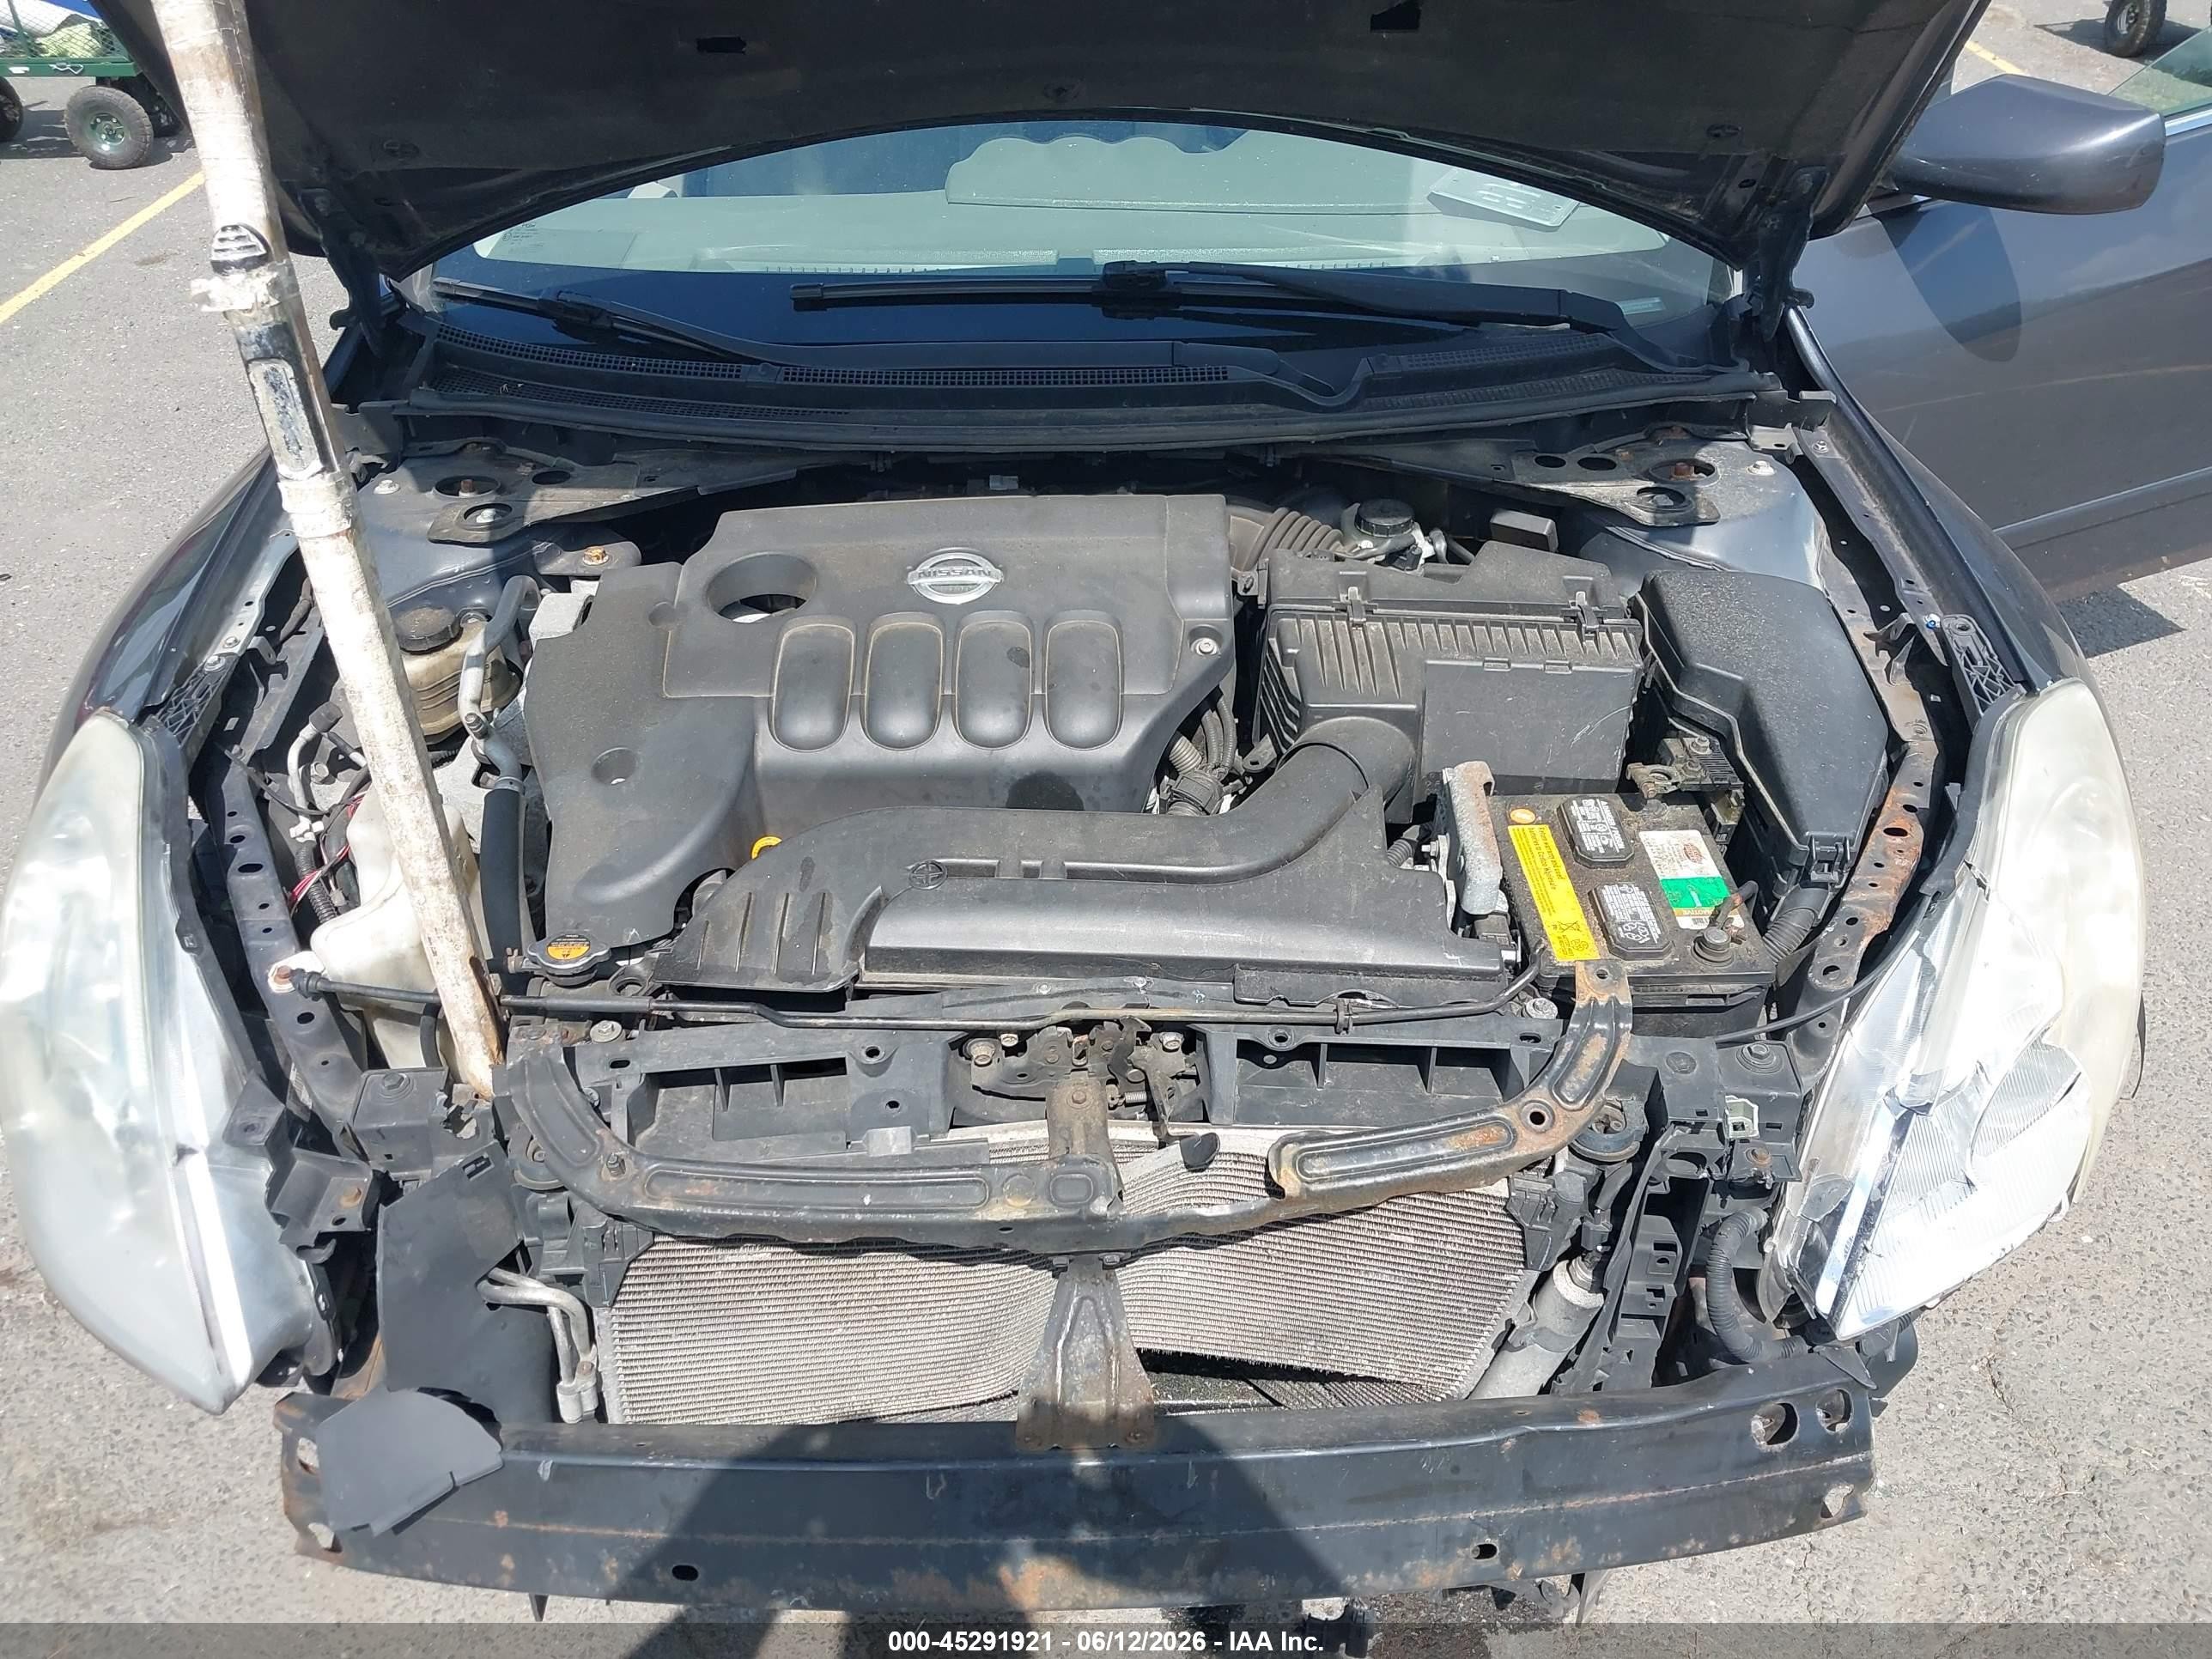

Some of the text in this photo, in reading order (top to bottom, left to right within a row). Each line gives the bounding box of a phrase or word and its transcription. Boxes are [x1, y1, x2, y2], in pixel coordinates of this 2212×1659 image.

[918, 568, 991, 578] NISSAN
[1528, 828, 1540, 846] batteries
[1536, 851, 1548, 867] Costco
[1543, 867, 1558, 890] Wholesale
[1538, 827, 1548, 842] Return
[1543, 842, 1555, 860] warranty
[1554, 868, 1565, 880] used
